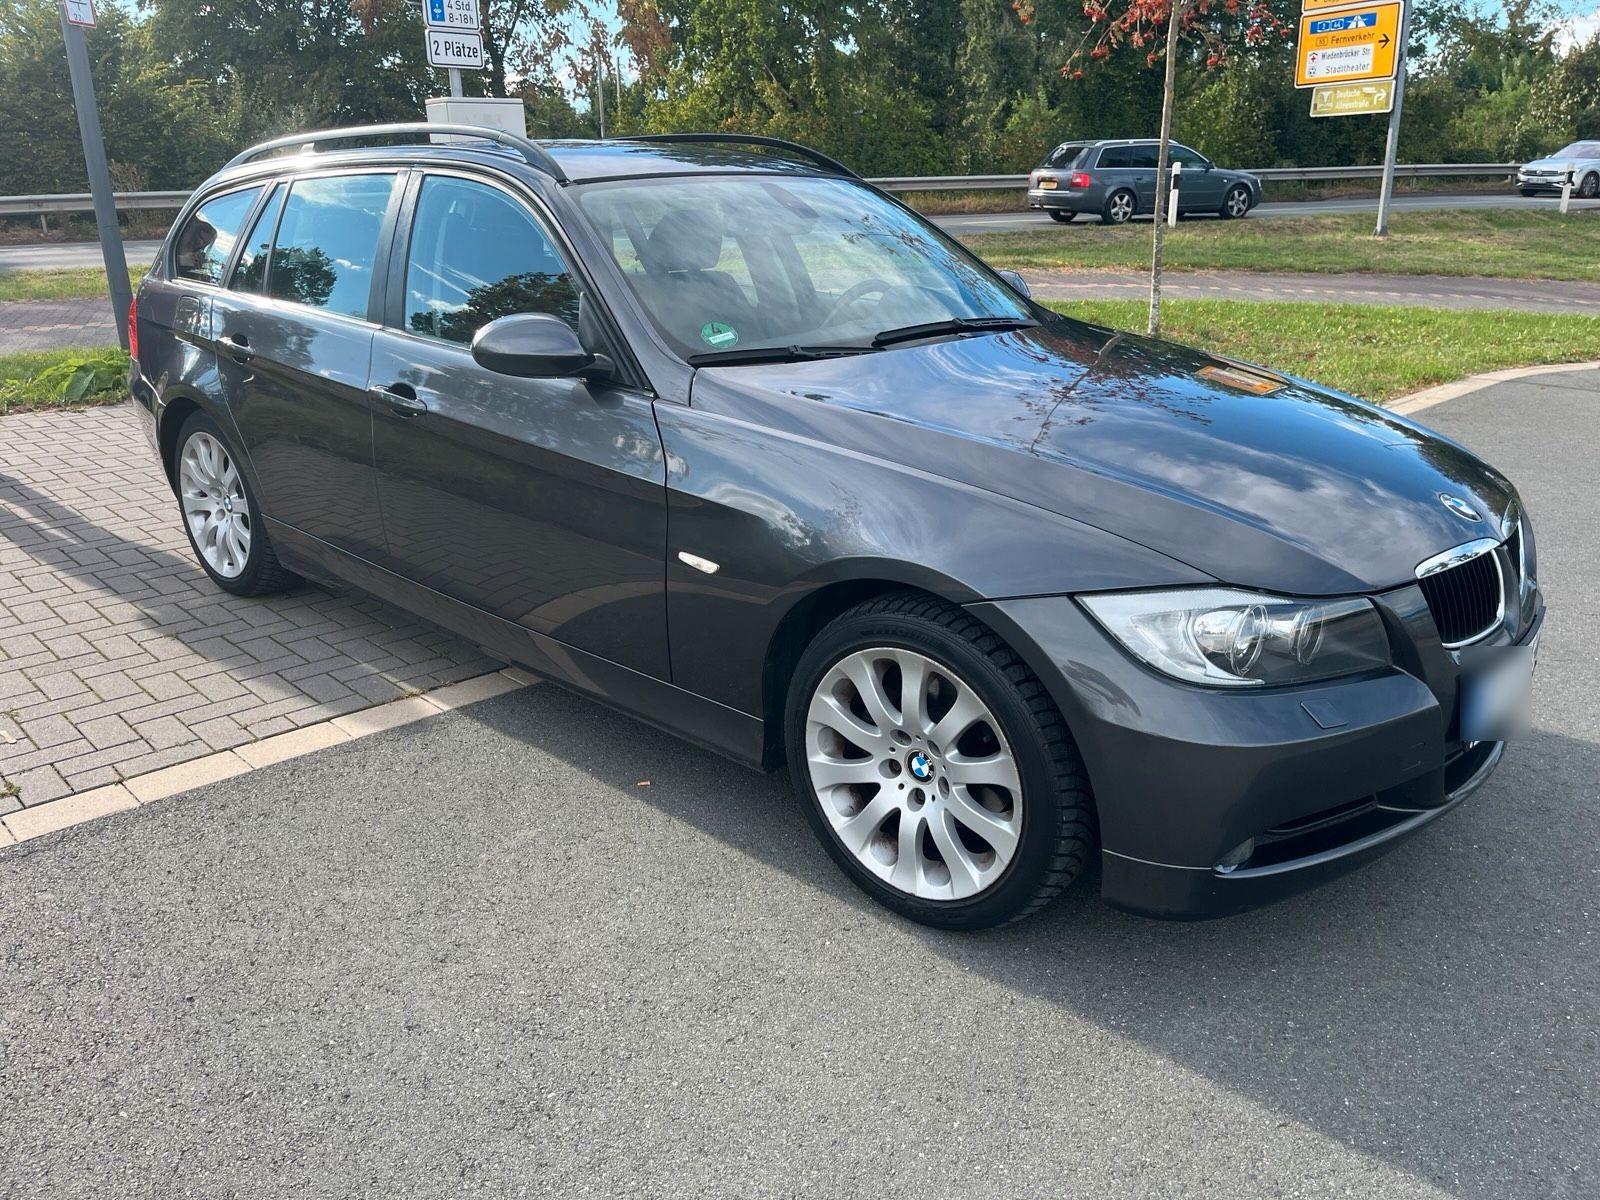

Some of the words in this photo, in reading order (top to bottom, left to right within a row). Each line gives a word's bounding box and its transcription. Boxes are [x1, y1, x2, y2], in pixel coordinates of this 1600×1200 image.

[455, 1, 473, 11] Std.
[449, 12, 474, 24] 8-18h
[1331, 33, 1375, 44] Fernverkehr
[433, 40, 440, 56] 2
[444, 40, 478, 58] Plätze
[1321, 48, 1360, 60] Wiedenbrücker
[1326, 63, 1370, 74] Stadttheater
